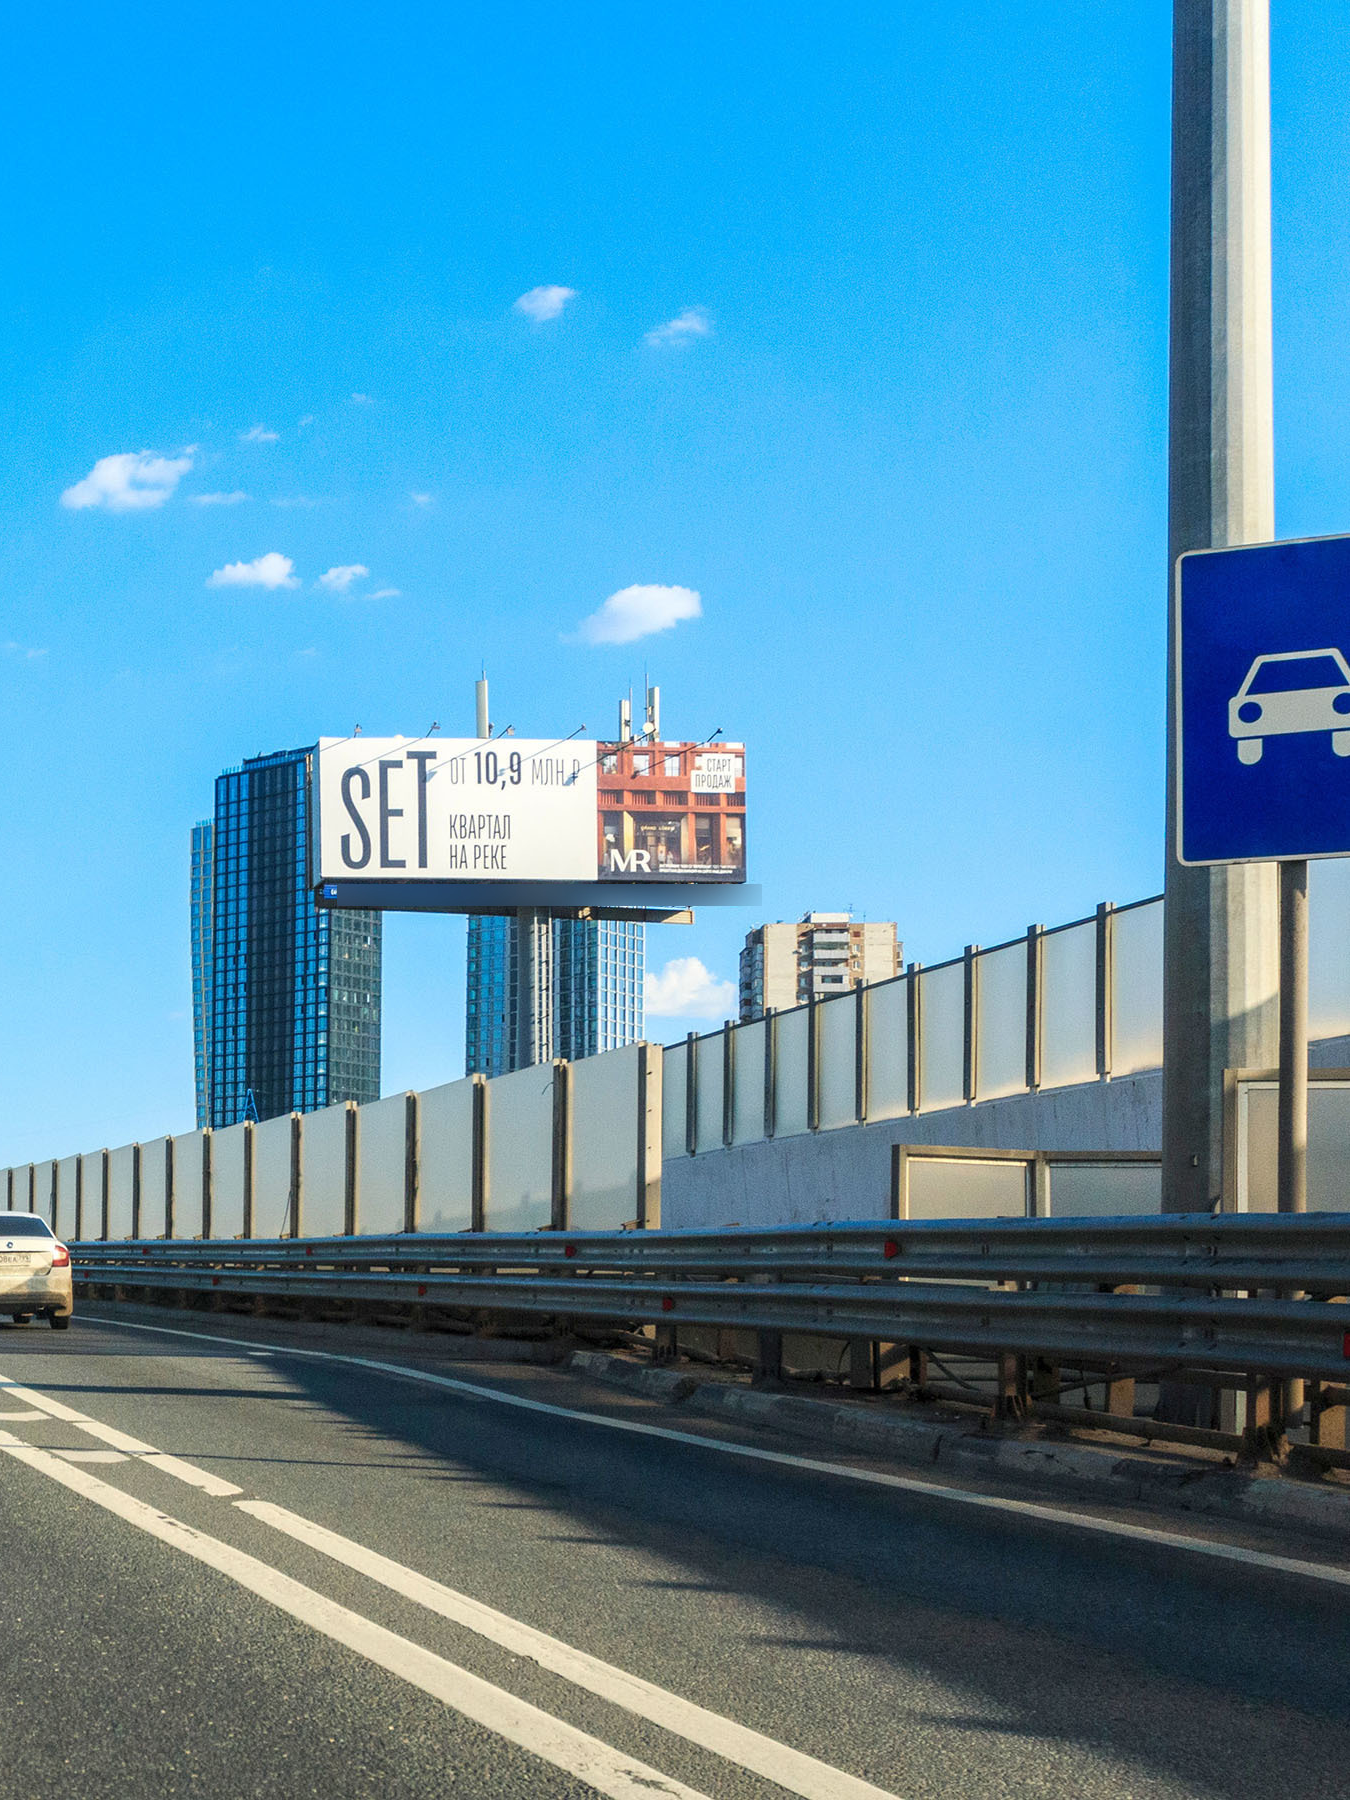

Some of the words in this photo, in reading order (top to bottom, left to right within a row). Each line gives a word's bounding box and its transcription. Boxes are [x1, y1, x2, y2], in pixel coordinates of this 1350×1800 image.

[450, 757, 466, 785] ОТ
[474, 751, 522, 790] 10,9
[531, 758, 564, 786] МЛН
[706, 758, 731, 772] СТАРТ
[695, 774, 732, 789] ПРОДАЖ
[340, 750, 437, 871] SET
[449, 814, 511, 840] КВАРТАЛ
[449, 844, 468, 869] НА
[474, 844, 507, 869] РЕКЕ
[610, 848, 652, 873] MR
